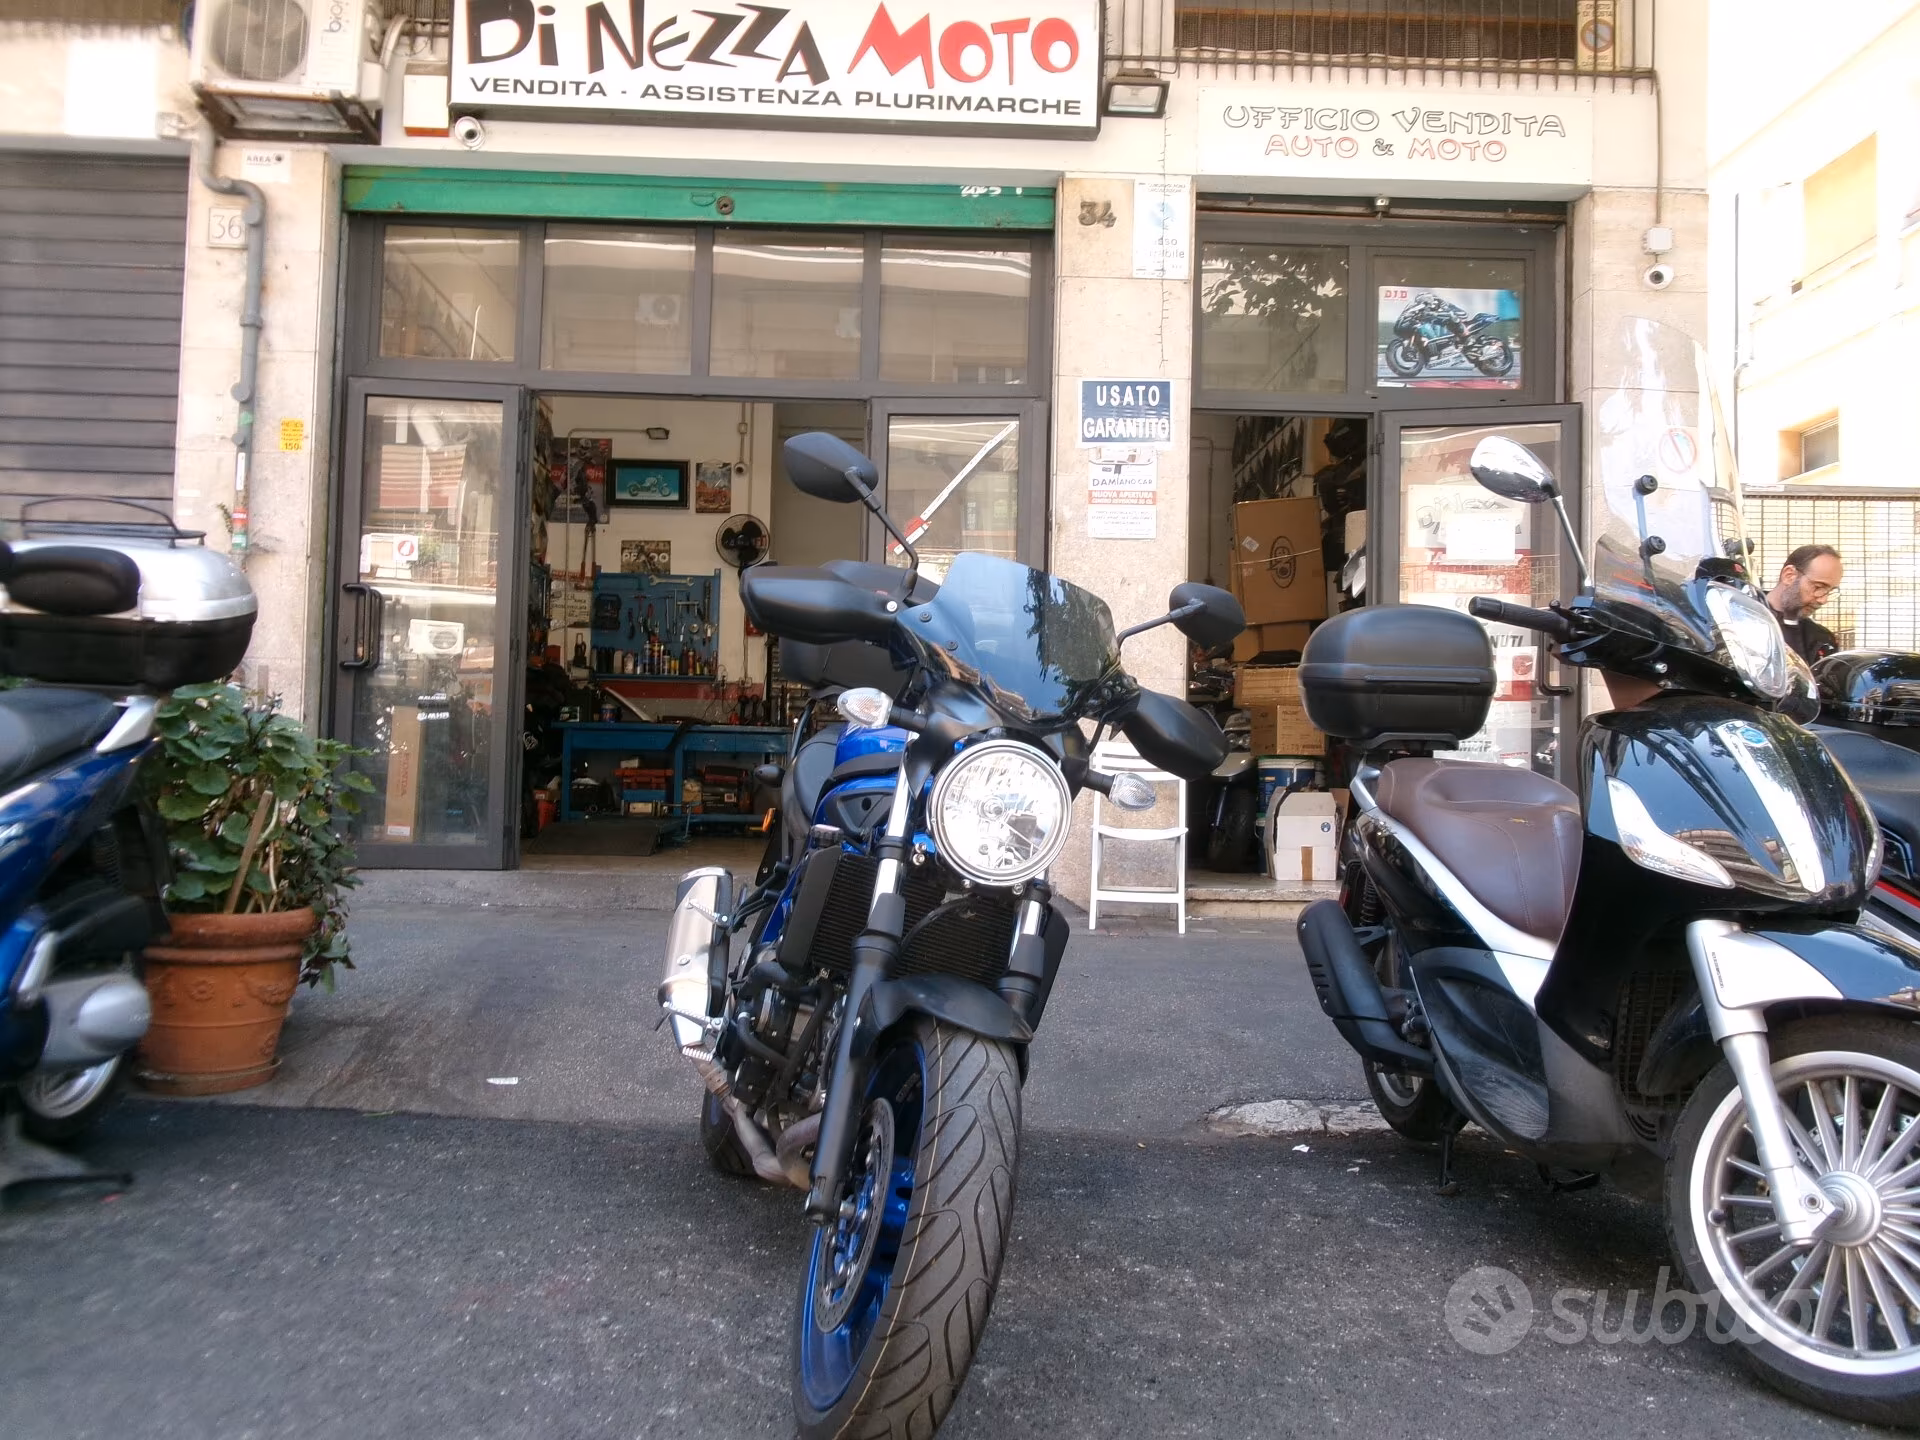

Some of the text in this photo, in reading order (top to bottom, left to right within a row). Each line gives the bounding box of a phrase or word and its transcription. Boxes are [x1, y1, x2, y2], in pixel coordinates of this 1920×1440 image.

[467, 0, 559, 66] Di
[847, 1, 1080, 89] MOTO
[469, 76, 607, 98] VENDITA
[640, 82, 841, 107] ASSISTENZA
[855, 90, 1082, 116] PLURIMARCHE
[1223, 105, 1566, 138] UFFICIO VENDITA
[1264, 134, 1507, 162] AUTO & MOTO
[212, 213, 243, 241] 36
[1078, 200, 1117, 228] 34
[1096, 385, 1160, 406] USATO
[1083, 417, 1170, 439] GARANTITO
